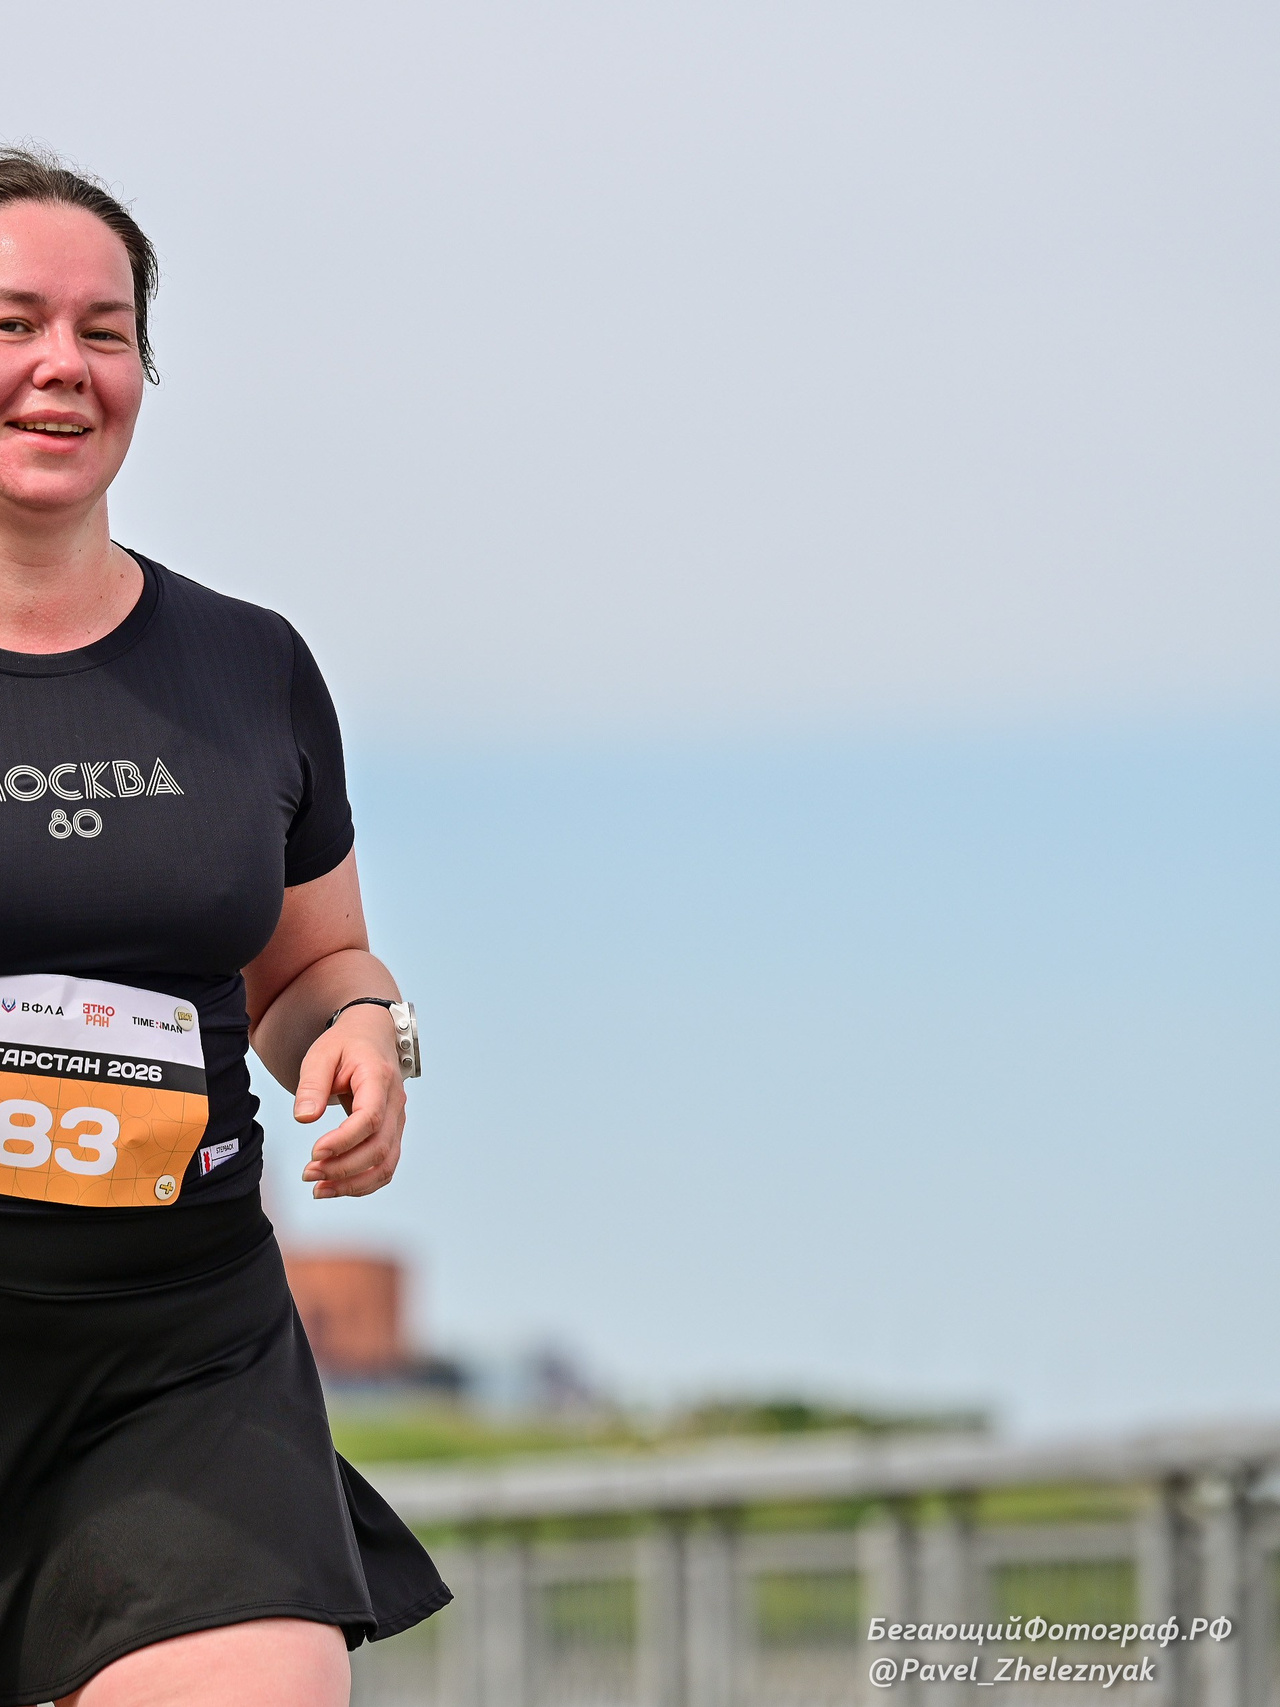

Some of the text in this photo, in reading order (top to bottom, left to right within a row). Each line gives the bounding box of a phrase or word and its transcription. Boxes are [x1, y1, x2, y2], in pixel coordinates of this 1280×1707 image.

[49, 809, 103, 839] 80
[21, 1002, 64, 1016] ВФЛА
[83, 1003, 115, 1017] ЭТНО
[86, 1014, 109, 1028] РАН
[107, 1060, 163, 1082] 2026
